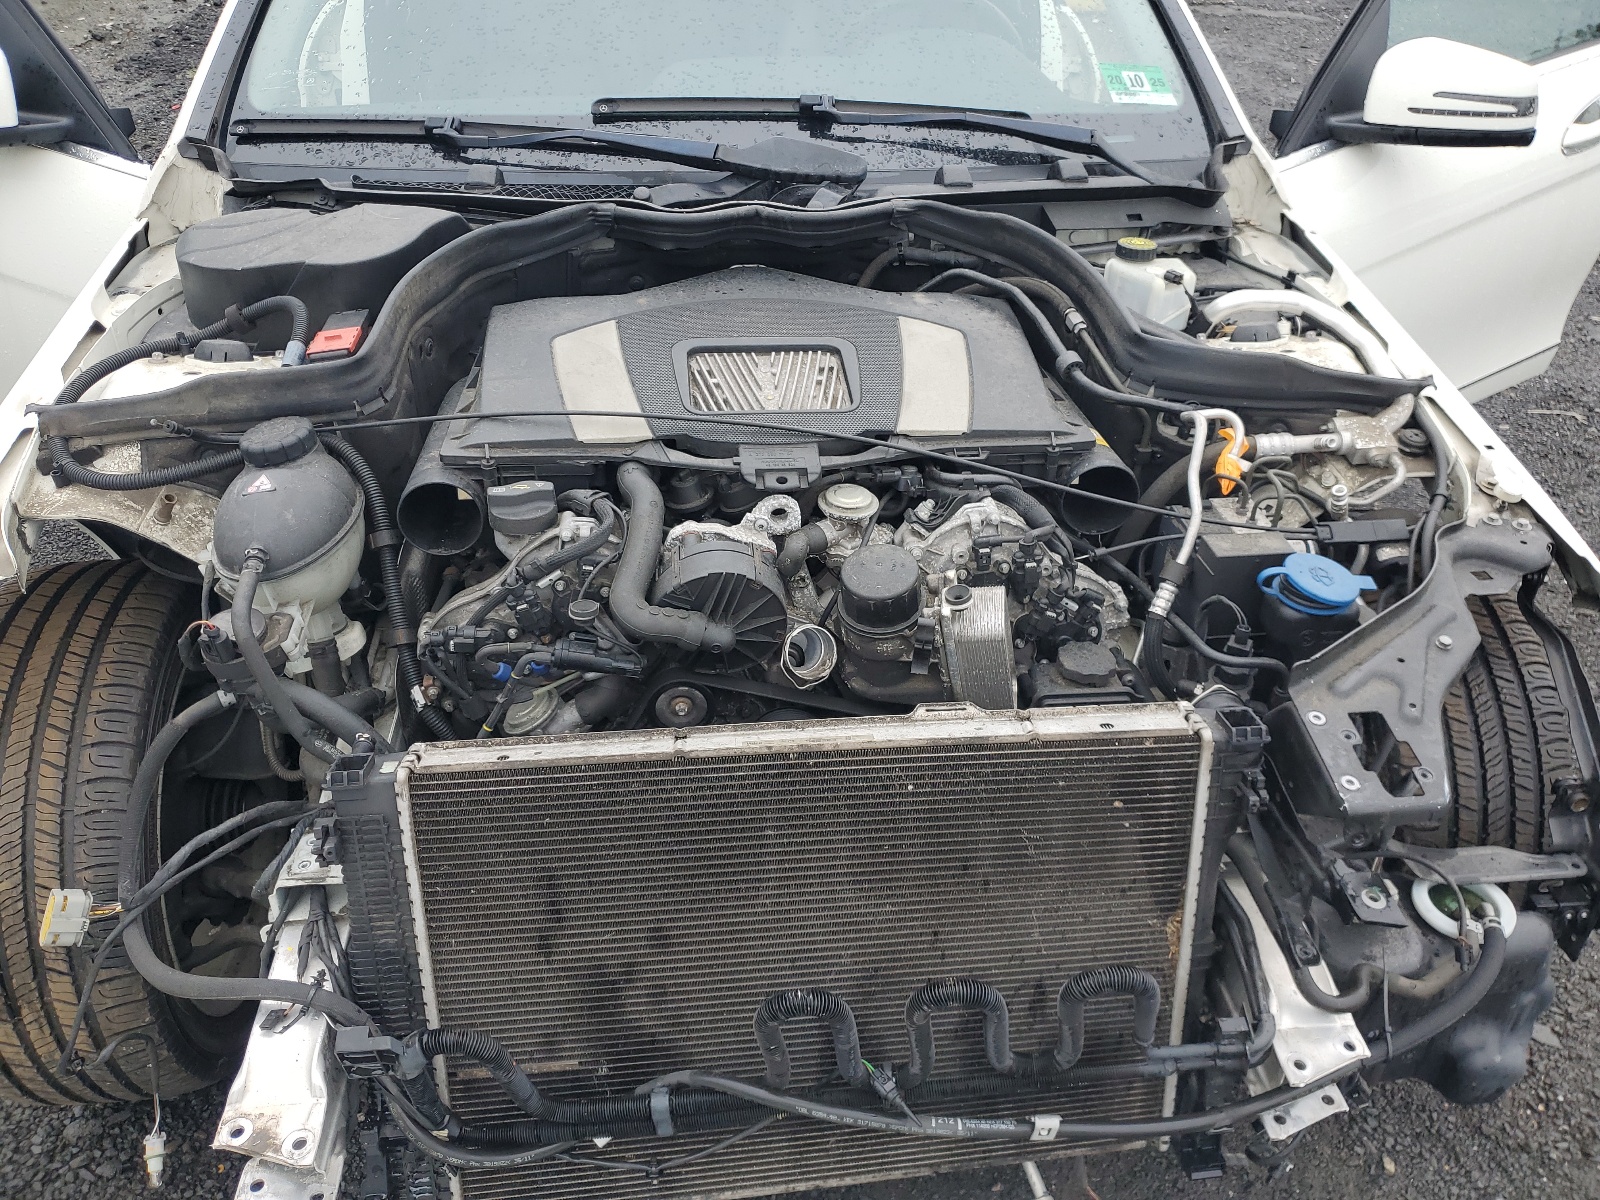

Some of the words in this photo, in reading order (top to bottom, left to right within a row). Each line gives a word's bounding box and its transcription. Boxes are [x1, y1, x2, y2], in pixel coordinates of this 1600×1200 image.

[1107, 75, 1123, 85] 20
[1127, 73, 1145, 88] 10
[1149, 77, 1166, 87] 25
[937, 1117, 955, 1125] 212
